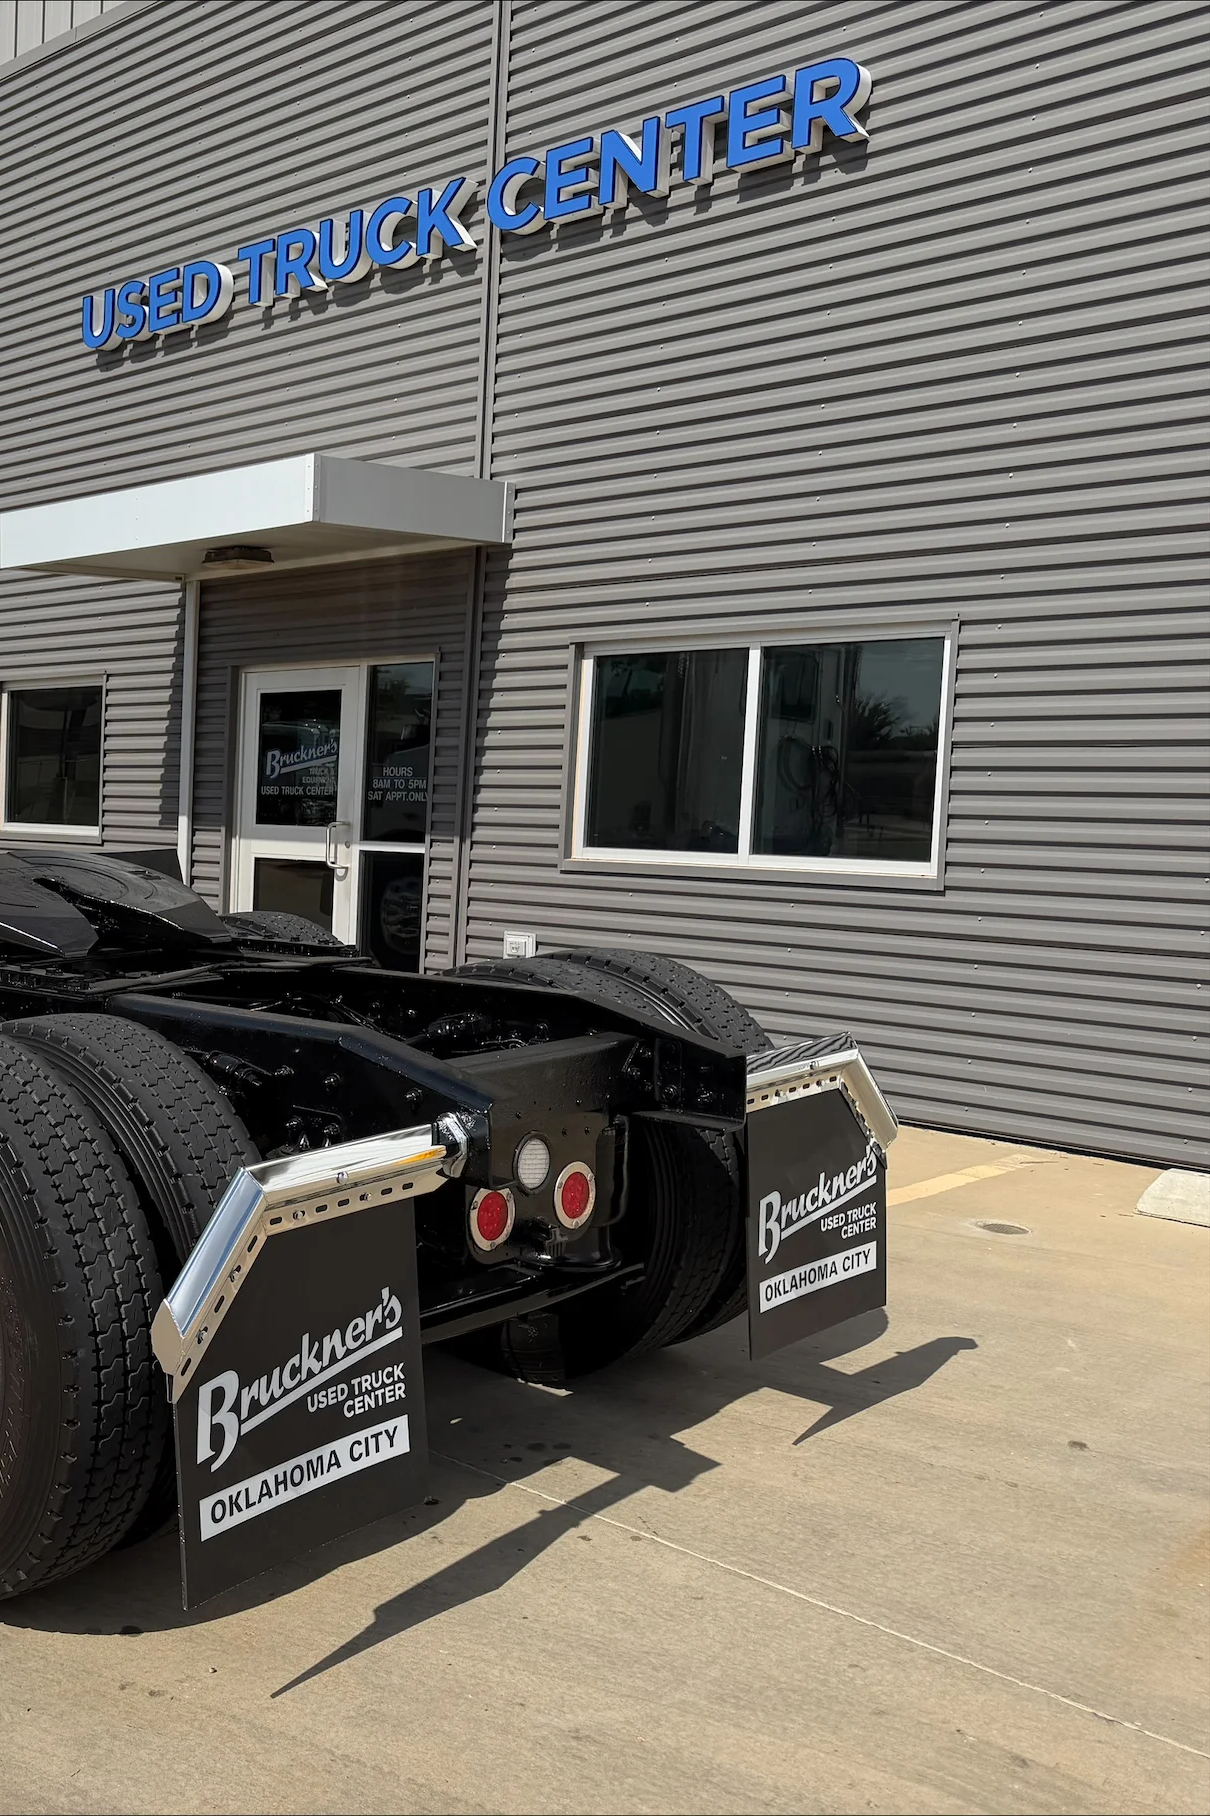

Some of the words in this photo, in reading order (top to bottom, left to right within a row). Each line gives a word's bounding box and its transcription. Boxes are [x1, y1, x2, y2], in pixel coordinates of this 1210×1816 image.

[81, 259, 231, 351] USED
[237, 176, 476, 308] TRUCK
[486, 57, 871, 234] CENTER
[265, 738, 337, 779] Bruckner's
[309, 766, 328, 775] TRUCK
[383, 766, 413, 777] HOURS
[261, 786, 279, 795] USED
[281, 786, 304, 796] TRUCK
[306, 786, 334, 796] CENTER
[302, 776, 335, 784] EQUIPMENT
[367, 790, 383, 801] SAT
[372, 778, 391, 789] 8AM
[394, 779, 405, 789] TO
[408, 779, 427, 789] 5PM
[758, 1145, 877, 1264] Bruckner's
[820, 1213, 846, 1232] USED
[847, 1201, 877, 1223] TRUCK
[841, 1216, 877, 1240] CENTER
[764, 1261, 838, 1302] OKLAHOMA
[842, 1248, 871, 1272] CITY
[196, 1286, 403, 1473] Bruckner's
[307, 1383, 348, 1413] USED
[351, 1362, 406, 1391] TRUCK
[343, 1382, 406, 1418] CENTER
[210, 1449, 342, 1524] OKLAHOMA
[349, 1425, 399, 1462] CITY
